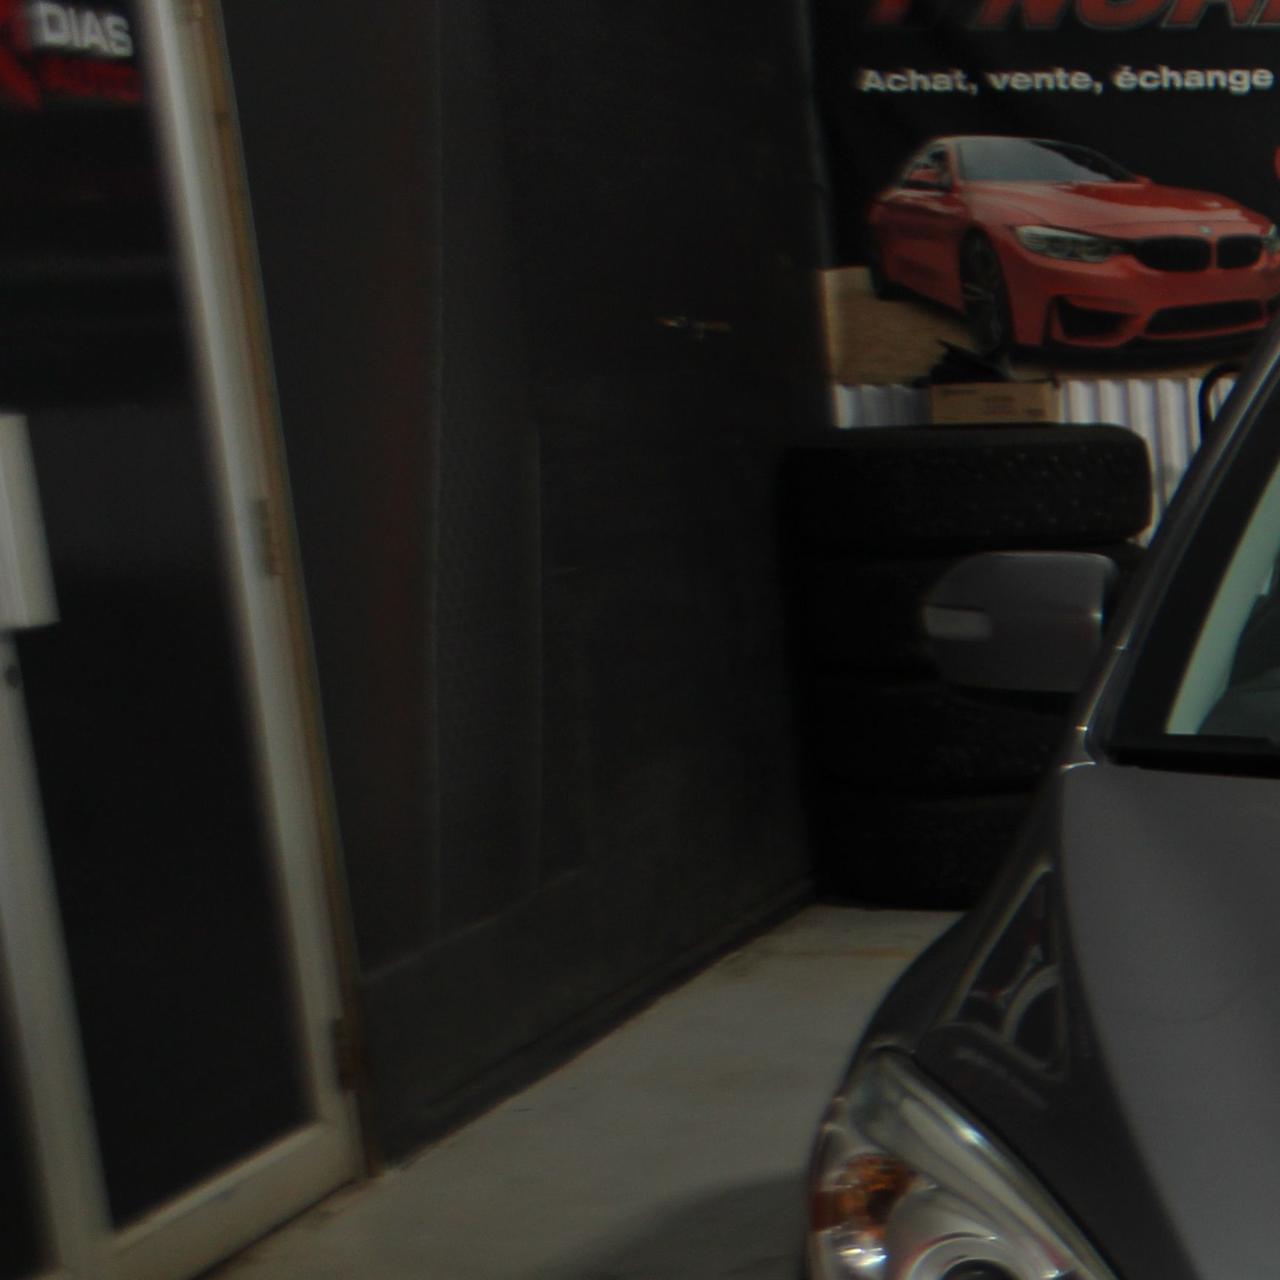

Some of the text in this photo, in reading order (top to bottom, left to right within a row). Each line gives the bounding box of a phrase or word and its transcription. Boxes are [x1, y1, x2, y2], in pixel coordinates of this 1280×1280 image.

[34, 2, 133, 57] DIAS
[861, 68, 978, 96] Achat,
[987, 67, 1103, 95] vente,
[1113, 66, 1274, 94] échange
